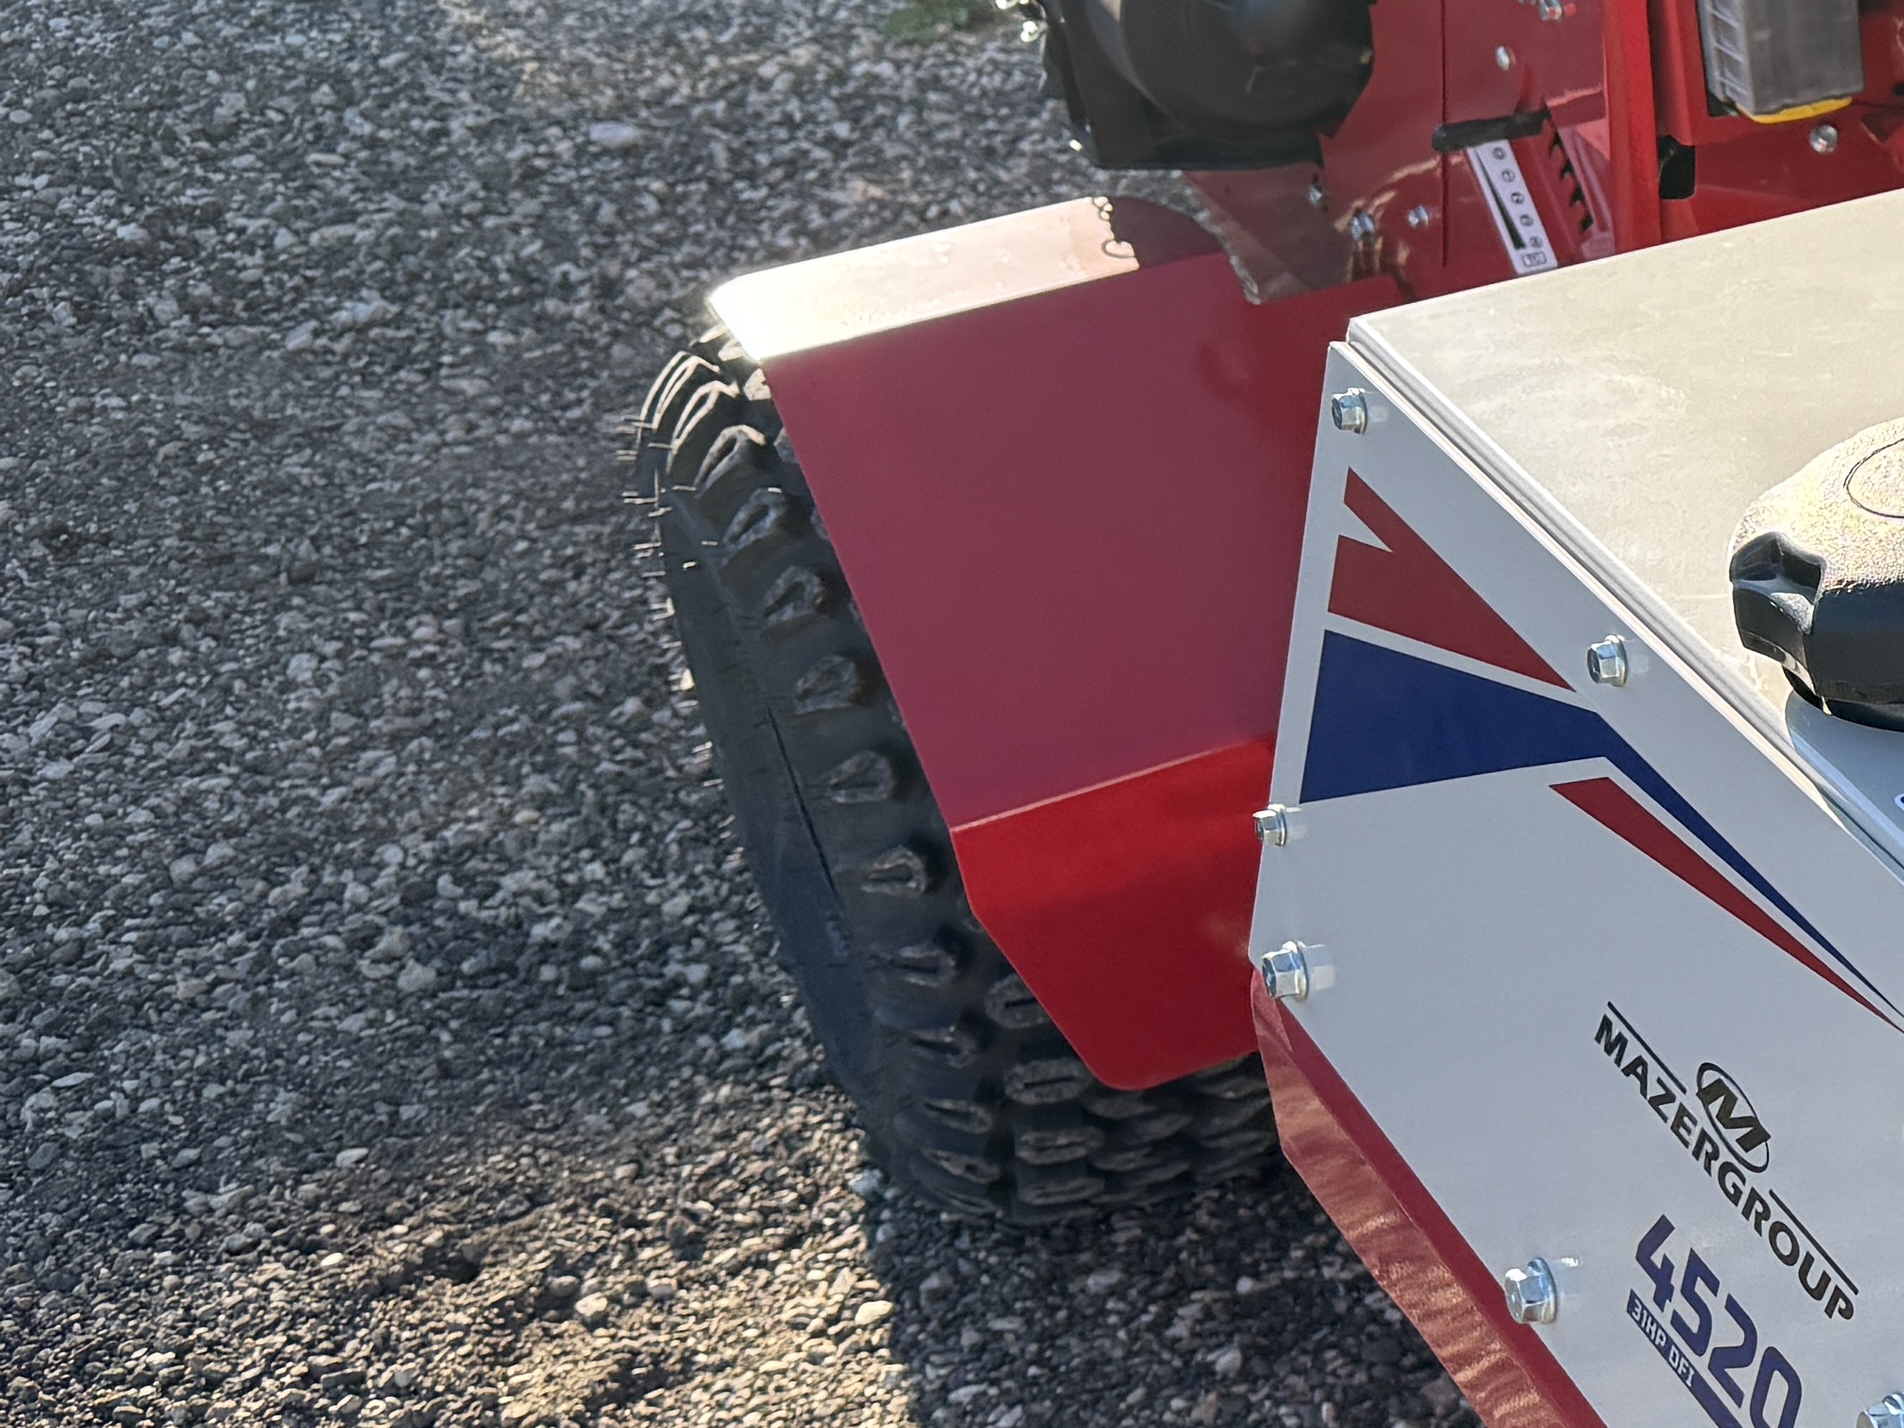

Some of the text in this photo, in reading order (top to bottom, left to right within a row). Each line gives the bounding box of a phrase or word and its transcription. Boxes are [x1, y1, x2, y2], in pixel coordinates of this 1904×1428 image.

[1593, 1013, 1855, 1320] MAZERGROUP
[1632, 1298, 1695, 1387] 31HP DFI
